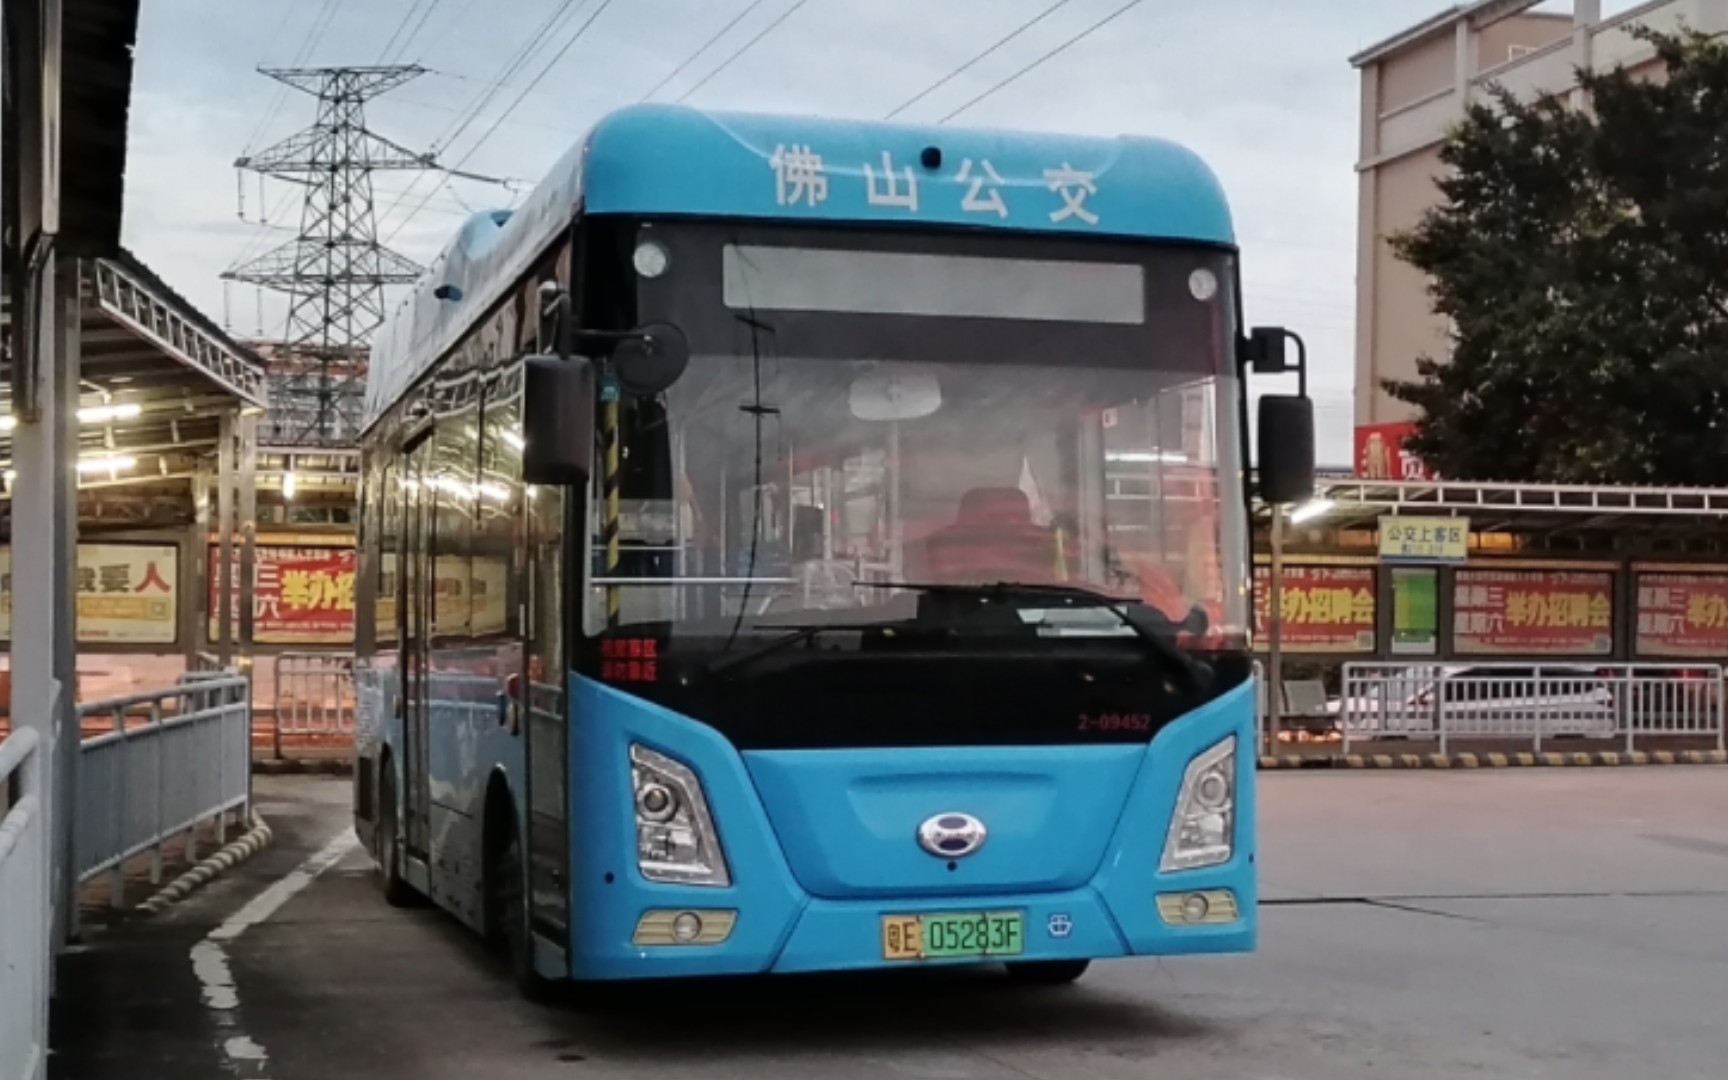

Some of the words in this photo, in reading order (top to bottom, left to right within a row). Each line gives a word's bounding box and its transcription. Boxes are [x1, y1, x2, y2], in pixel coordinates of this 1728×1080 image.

[769, 143, 1099, 225] 佛山公交
[1387, 525, 1463, 543] 公交上客区
[1506, 591, 1610, 627] 举办招聘会
[1077, 713, 1152, 731] 2-09452
